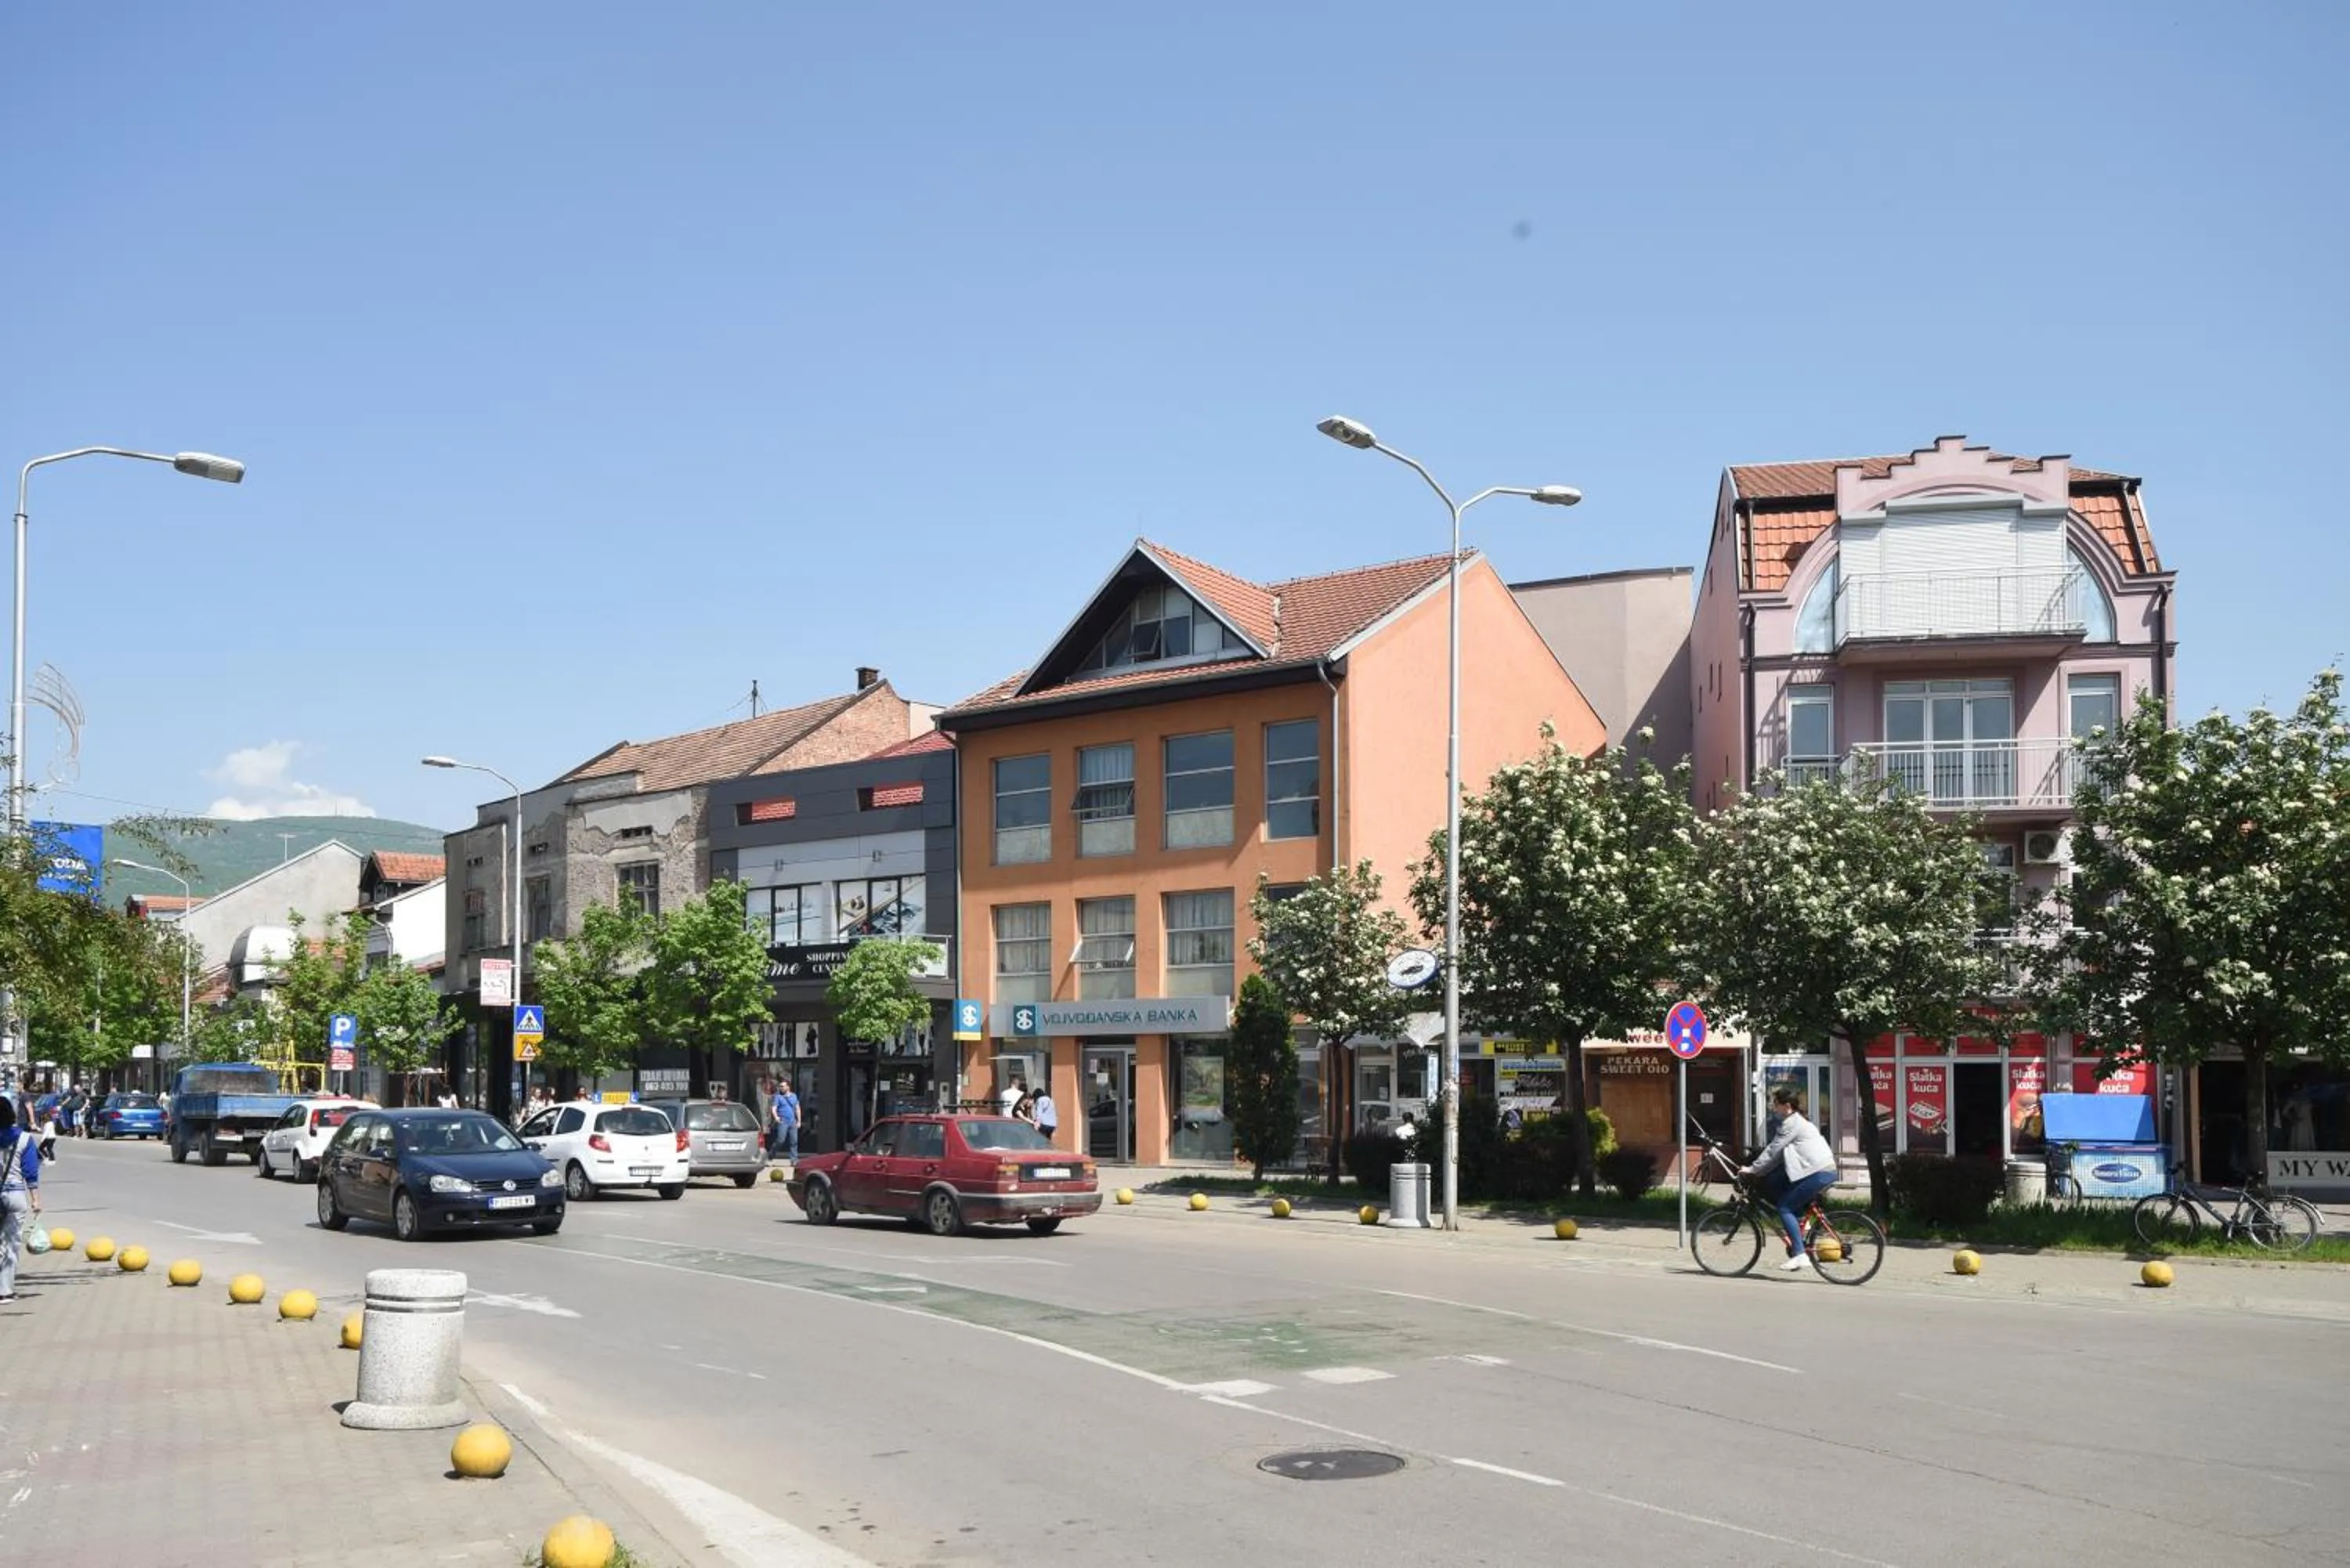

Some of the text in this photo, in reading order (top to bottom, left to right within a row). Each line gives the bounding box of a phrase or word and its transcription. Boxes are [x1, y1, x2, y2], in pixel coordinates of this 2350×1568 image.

[805, 952, 851, 962] SHOPPIN
[1148, 1009, 1198, 1021] BANKA
[334, 1017, 351, 1036] P
[1600, 1064, 1642, 1074] SWEET
[2012, 1068, 2045, 1079] Slatka
[1909, 1070, 1942, 1082] Slatka
[2279, 1160, 2350, 1176] MY W
